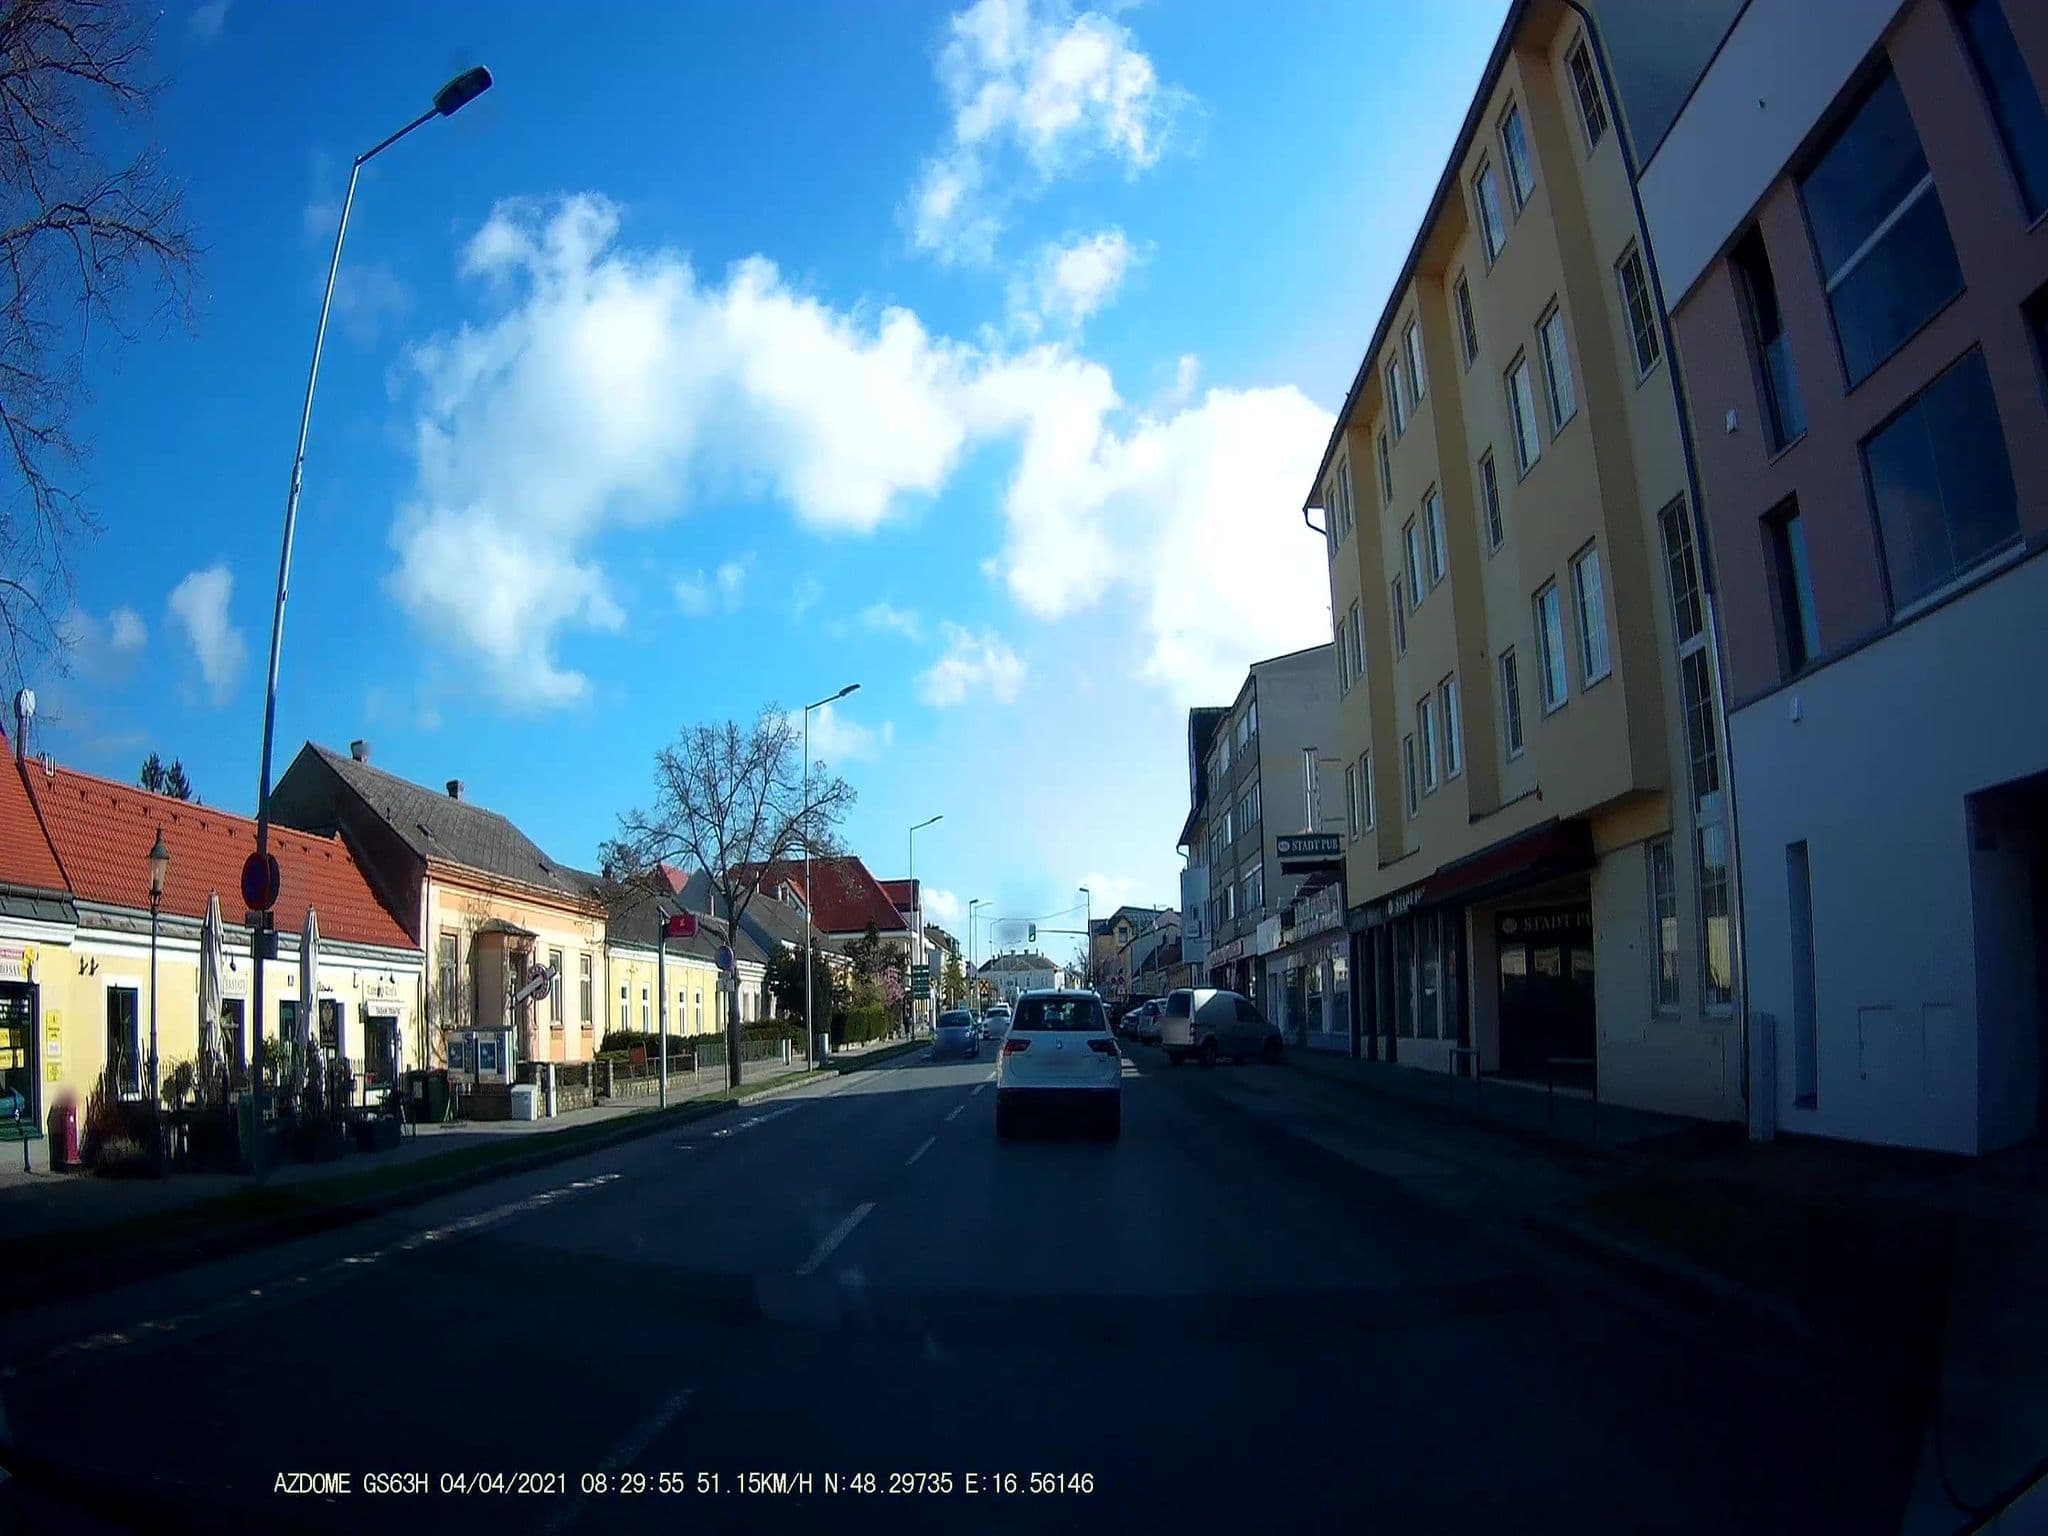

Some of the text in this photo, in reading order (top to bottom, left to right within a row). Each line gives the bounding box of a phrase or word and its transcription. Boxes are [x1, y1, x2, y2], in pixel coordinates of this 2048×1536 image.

[1291, 839, 1320, 852] STADT
[1321, 838, 1338, 851] PUB
[1524, 911, 1592, 931] STADT PU
